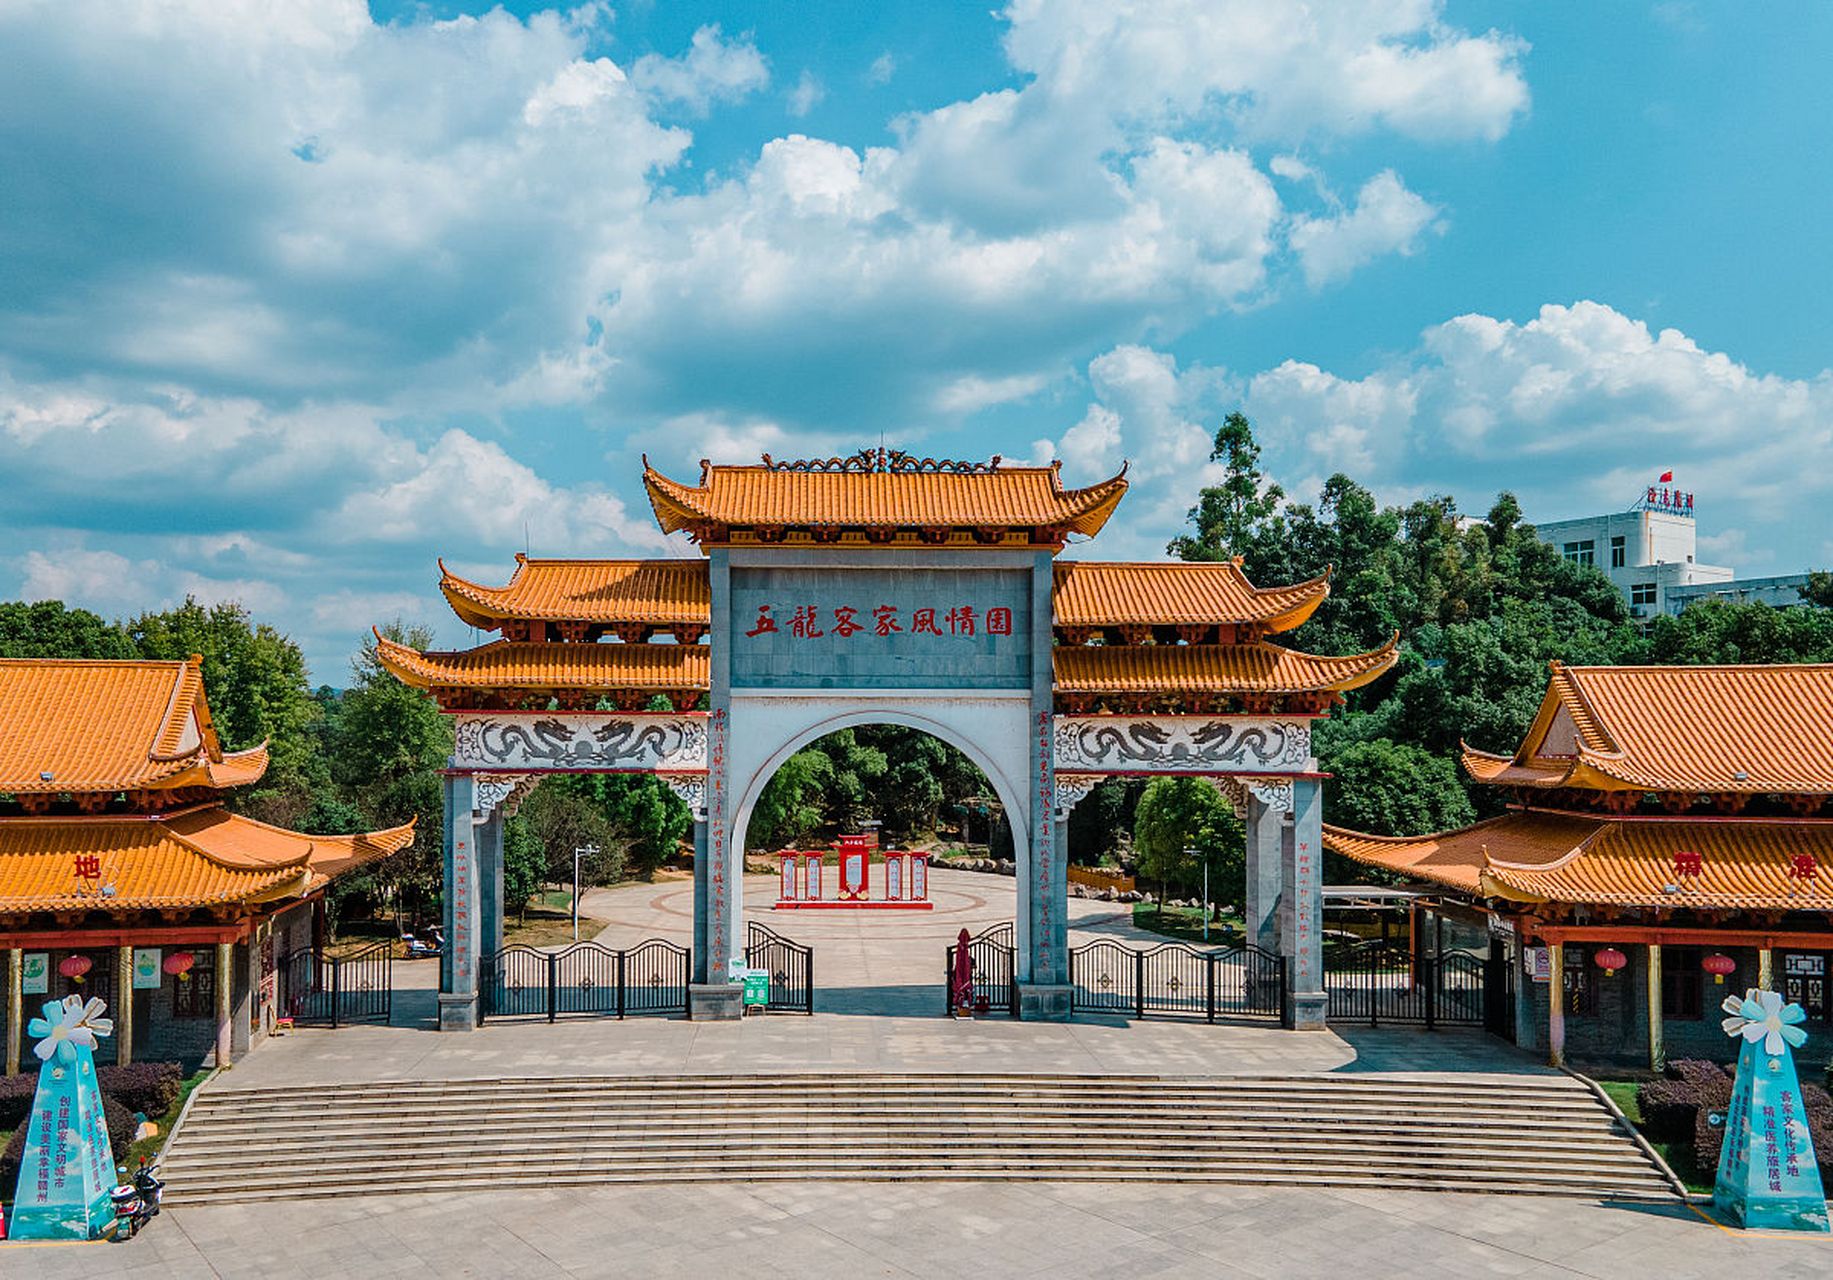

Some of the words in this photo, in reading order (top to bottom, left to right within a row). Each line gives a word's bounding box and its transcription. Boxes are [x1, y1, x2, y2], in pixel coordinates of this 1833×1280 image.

[745, 605, 1013, 639] 五龍客家風情園
[73, 854, 102, 879] 地
[54, 1095, 71, 1188] 创建国家文明城市
[1779, 1090, 1801, 1177] 客家文化传承地
